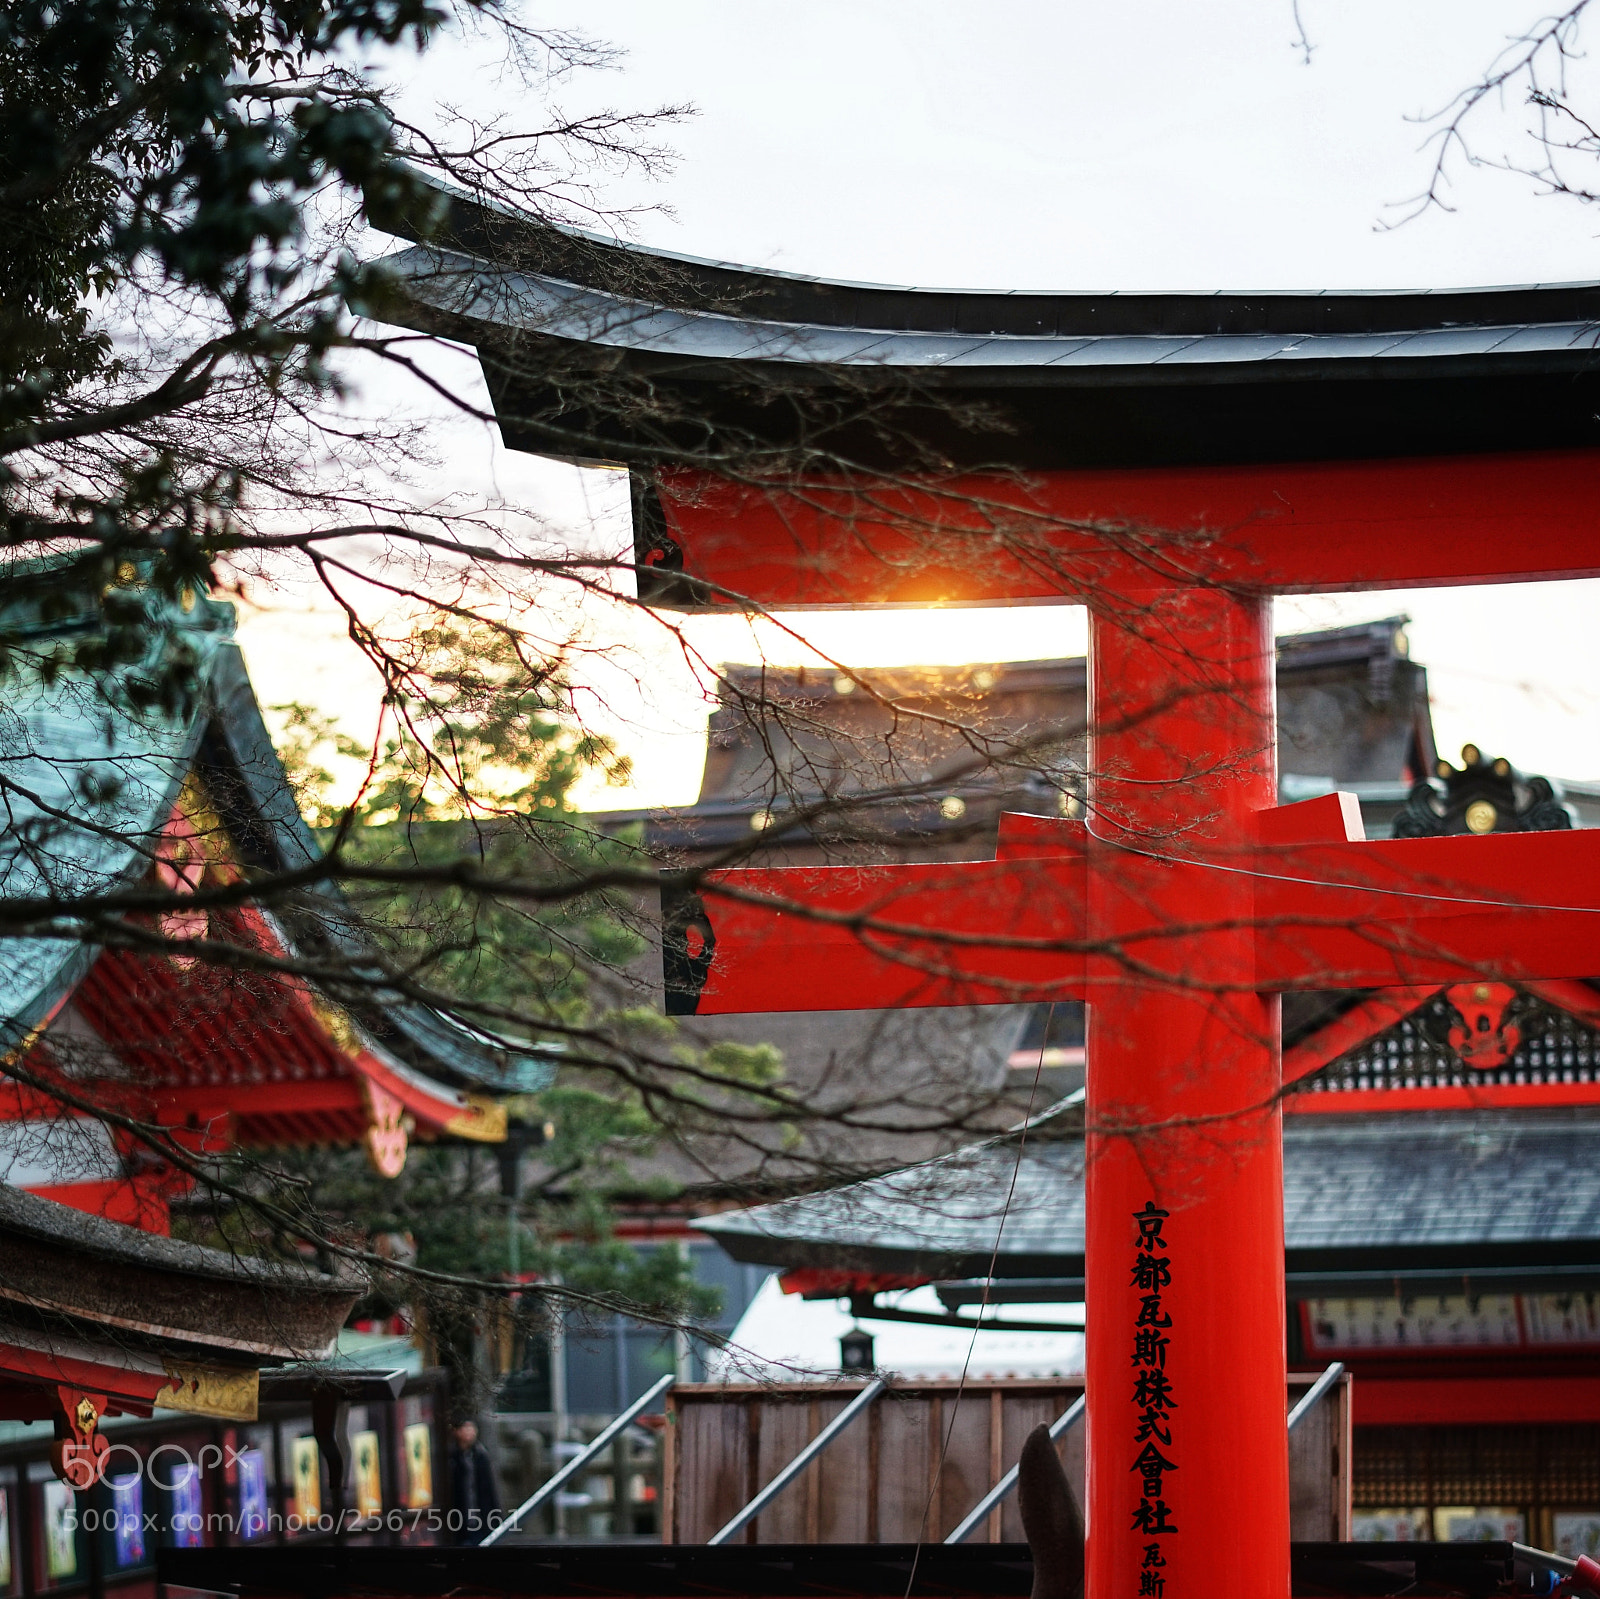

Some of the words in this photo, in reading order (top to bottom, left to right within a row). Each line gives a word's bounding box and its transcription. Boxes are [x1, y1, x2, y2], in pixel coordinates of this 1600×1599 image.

[1129, 1201, 1179, 1535] 京都瓦斯株式會社
